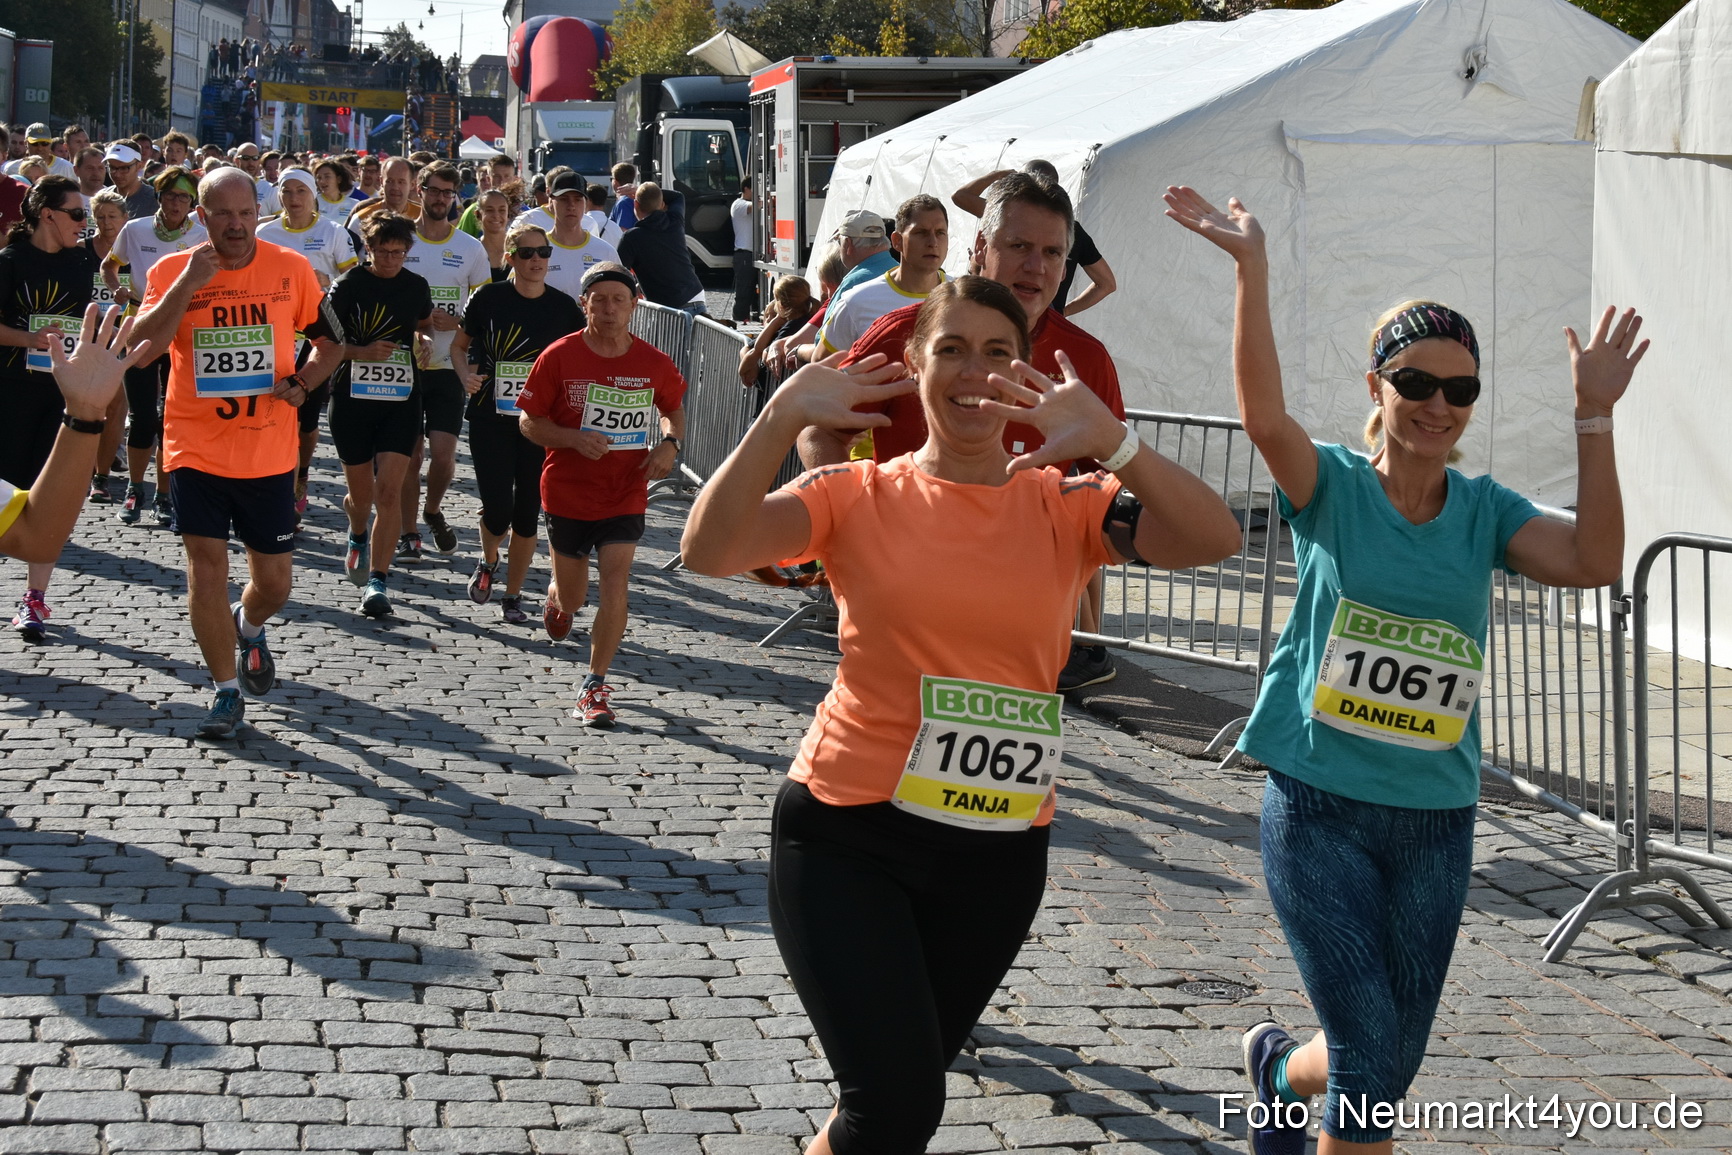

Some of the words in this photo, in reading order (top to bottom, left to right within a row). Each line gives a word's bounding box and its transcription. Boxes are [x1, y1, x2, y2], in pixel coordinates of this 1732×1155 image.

[308, 90, 358, 104] START
[201, 290, 219, 299] SPORT
[271, 294, 291, 303] SPEED
[198, 329, 265, 346] BOCK
[202, 350, 265, 374] 2832
[359, 365, 406, 383] 2592
[366, 386, 397, 395] MARIA
[593, 388, 648, 406] BOCK
[590, 407, 645, 430] 2500
[1344, 609, 1471, 662] BOCK
[1344, 650, 1459, 707] 1061
[1466, 679, 1474, 688] D
[934, 687, 1050, 729] BOCK
[1338, 699, 1436, 735] DANIELA
[936, 731, 1044, 785] 1062
[1048, 748, 1056, 757] D
[941, 788, 1010, 814] TANJA
